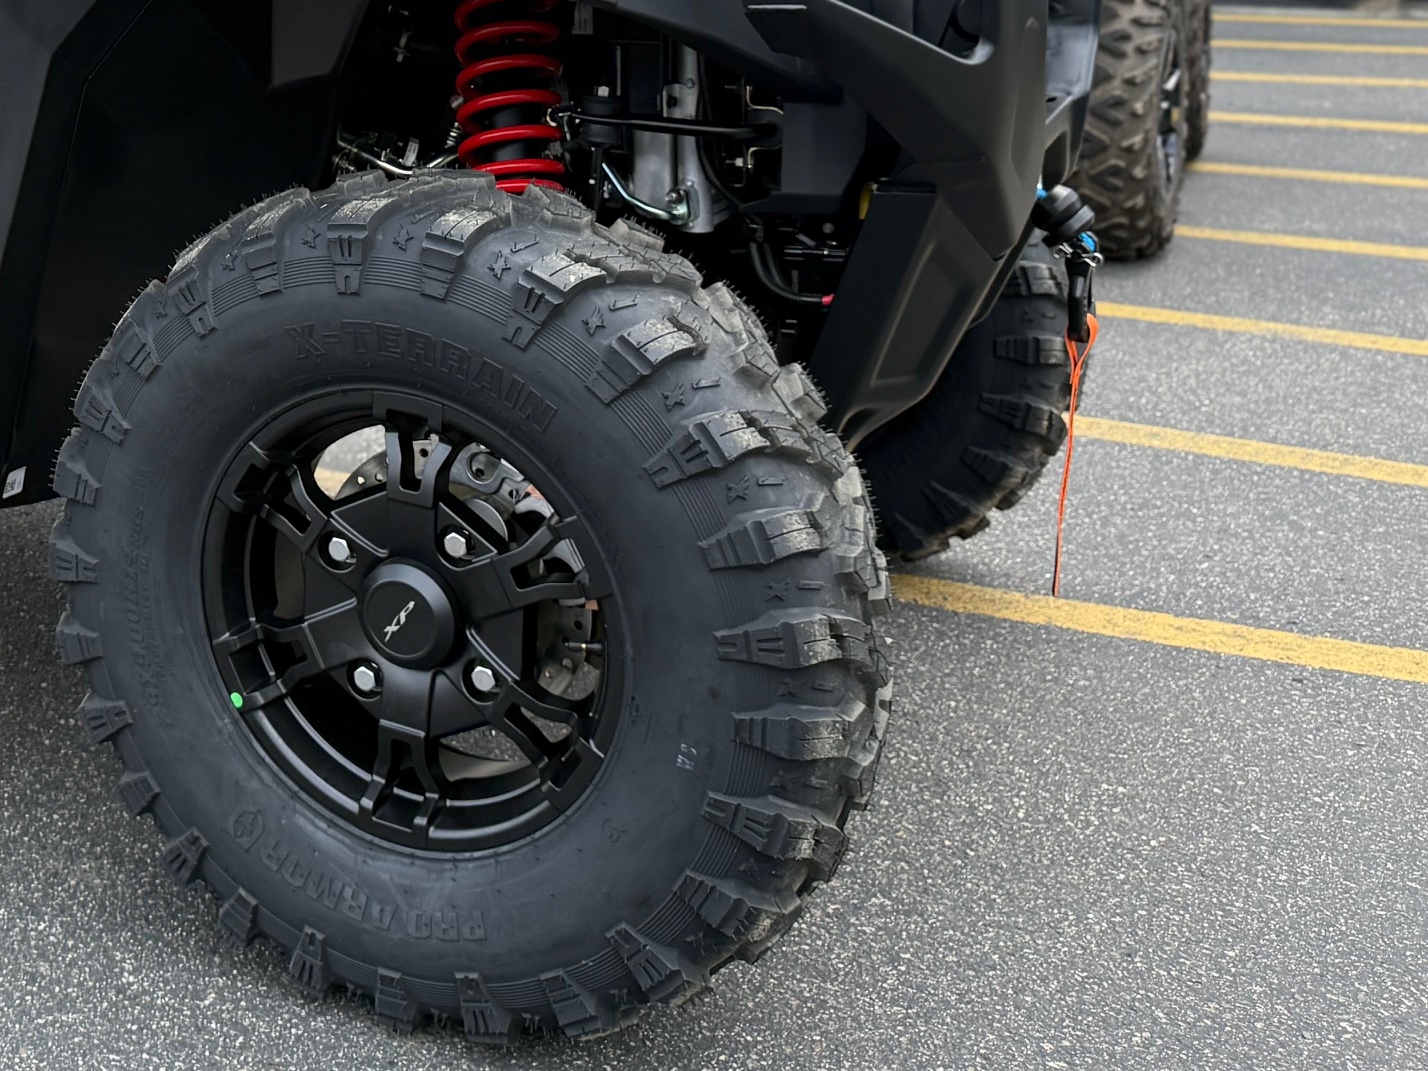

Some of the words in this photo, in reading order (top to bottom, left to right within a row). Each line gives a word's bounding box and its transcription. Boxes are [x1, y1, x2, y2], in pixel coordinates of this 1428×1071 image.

[285, 318, 559, 433] X-TERRAIN
[383, 601, 416, 643] XP
[259, 841, 400, 930] ARMOR
[407, 909, 488, 942] PRO
